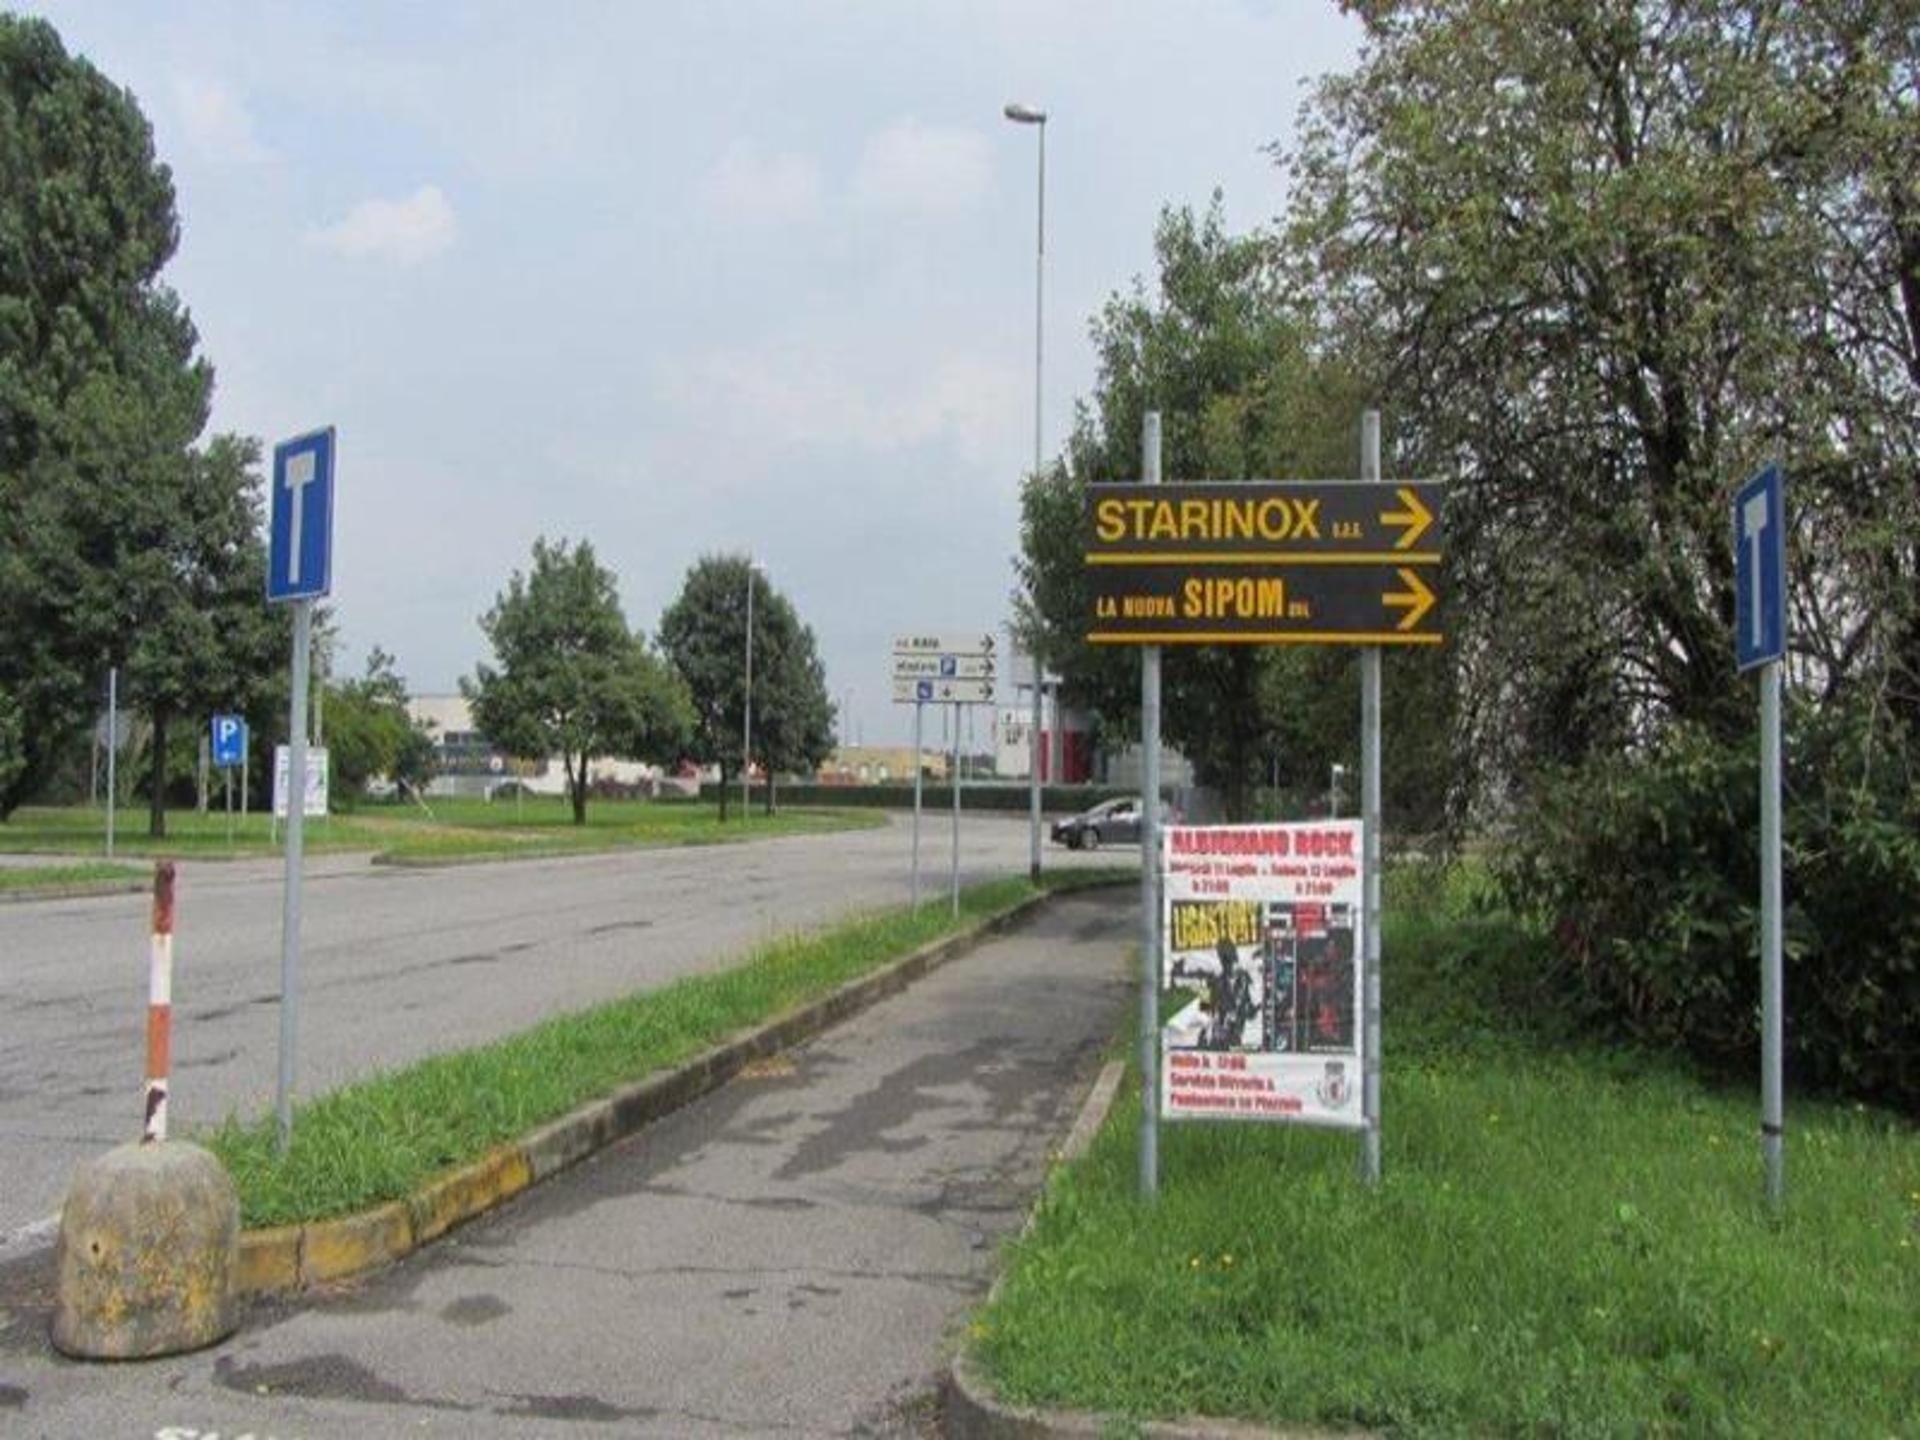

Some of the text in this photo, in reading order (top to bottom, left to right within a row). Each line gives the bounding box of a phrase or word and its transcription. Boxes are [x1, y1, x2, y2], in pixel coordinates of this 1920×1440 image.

[1096, 499, 1321, 542] STARINOX
[1097, 597, 1117, 617] LA
[1123, 597, 1175, 617] NUOVA
[1184, 578, 1284, 618] SIPOM
[1295, 830, 1354, 857] ROCK
